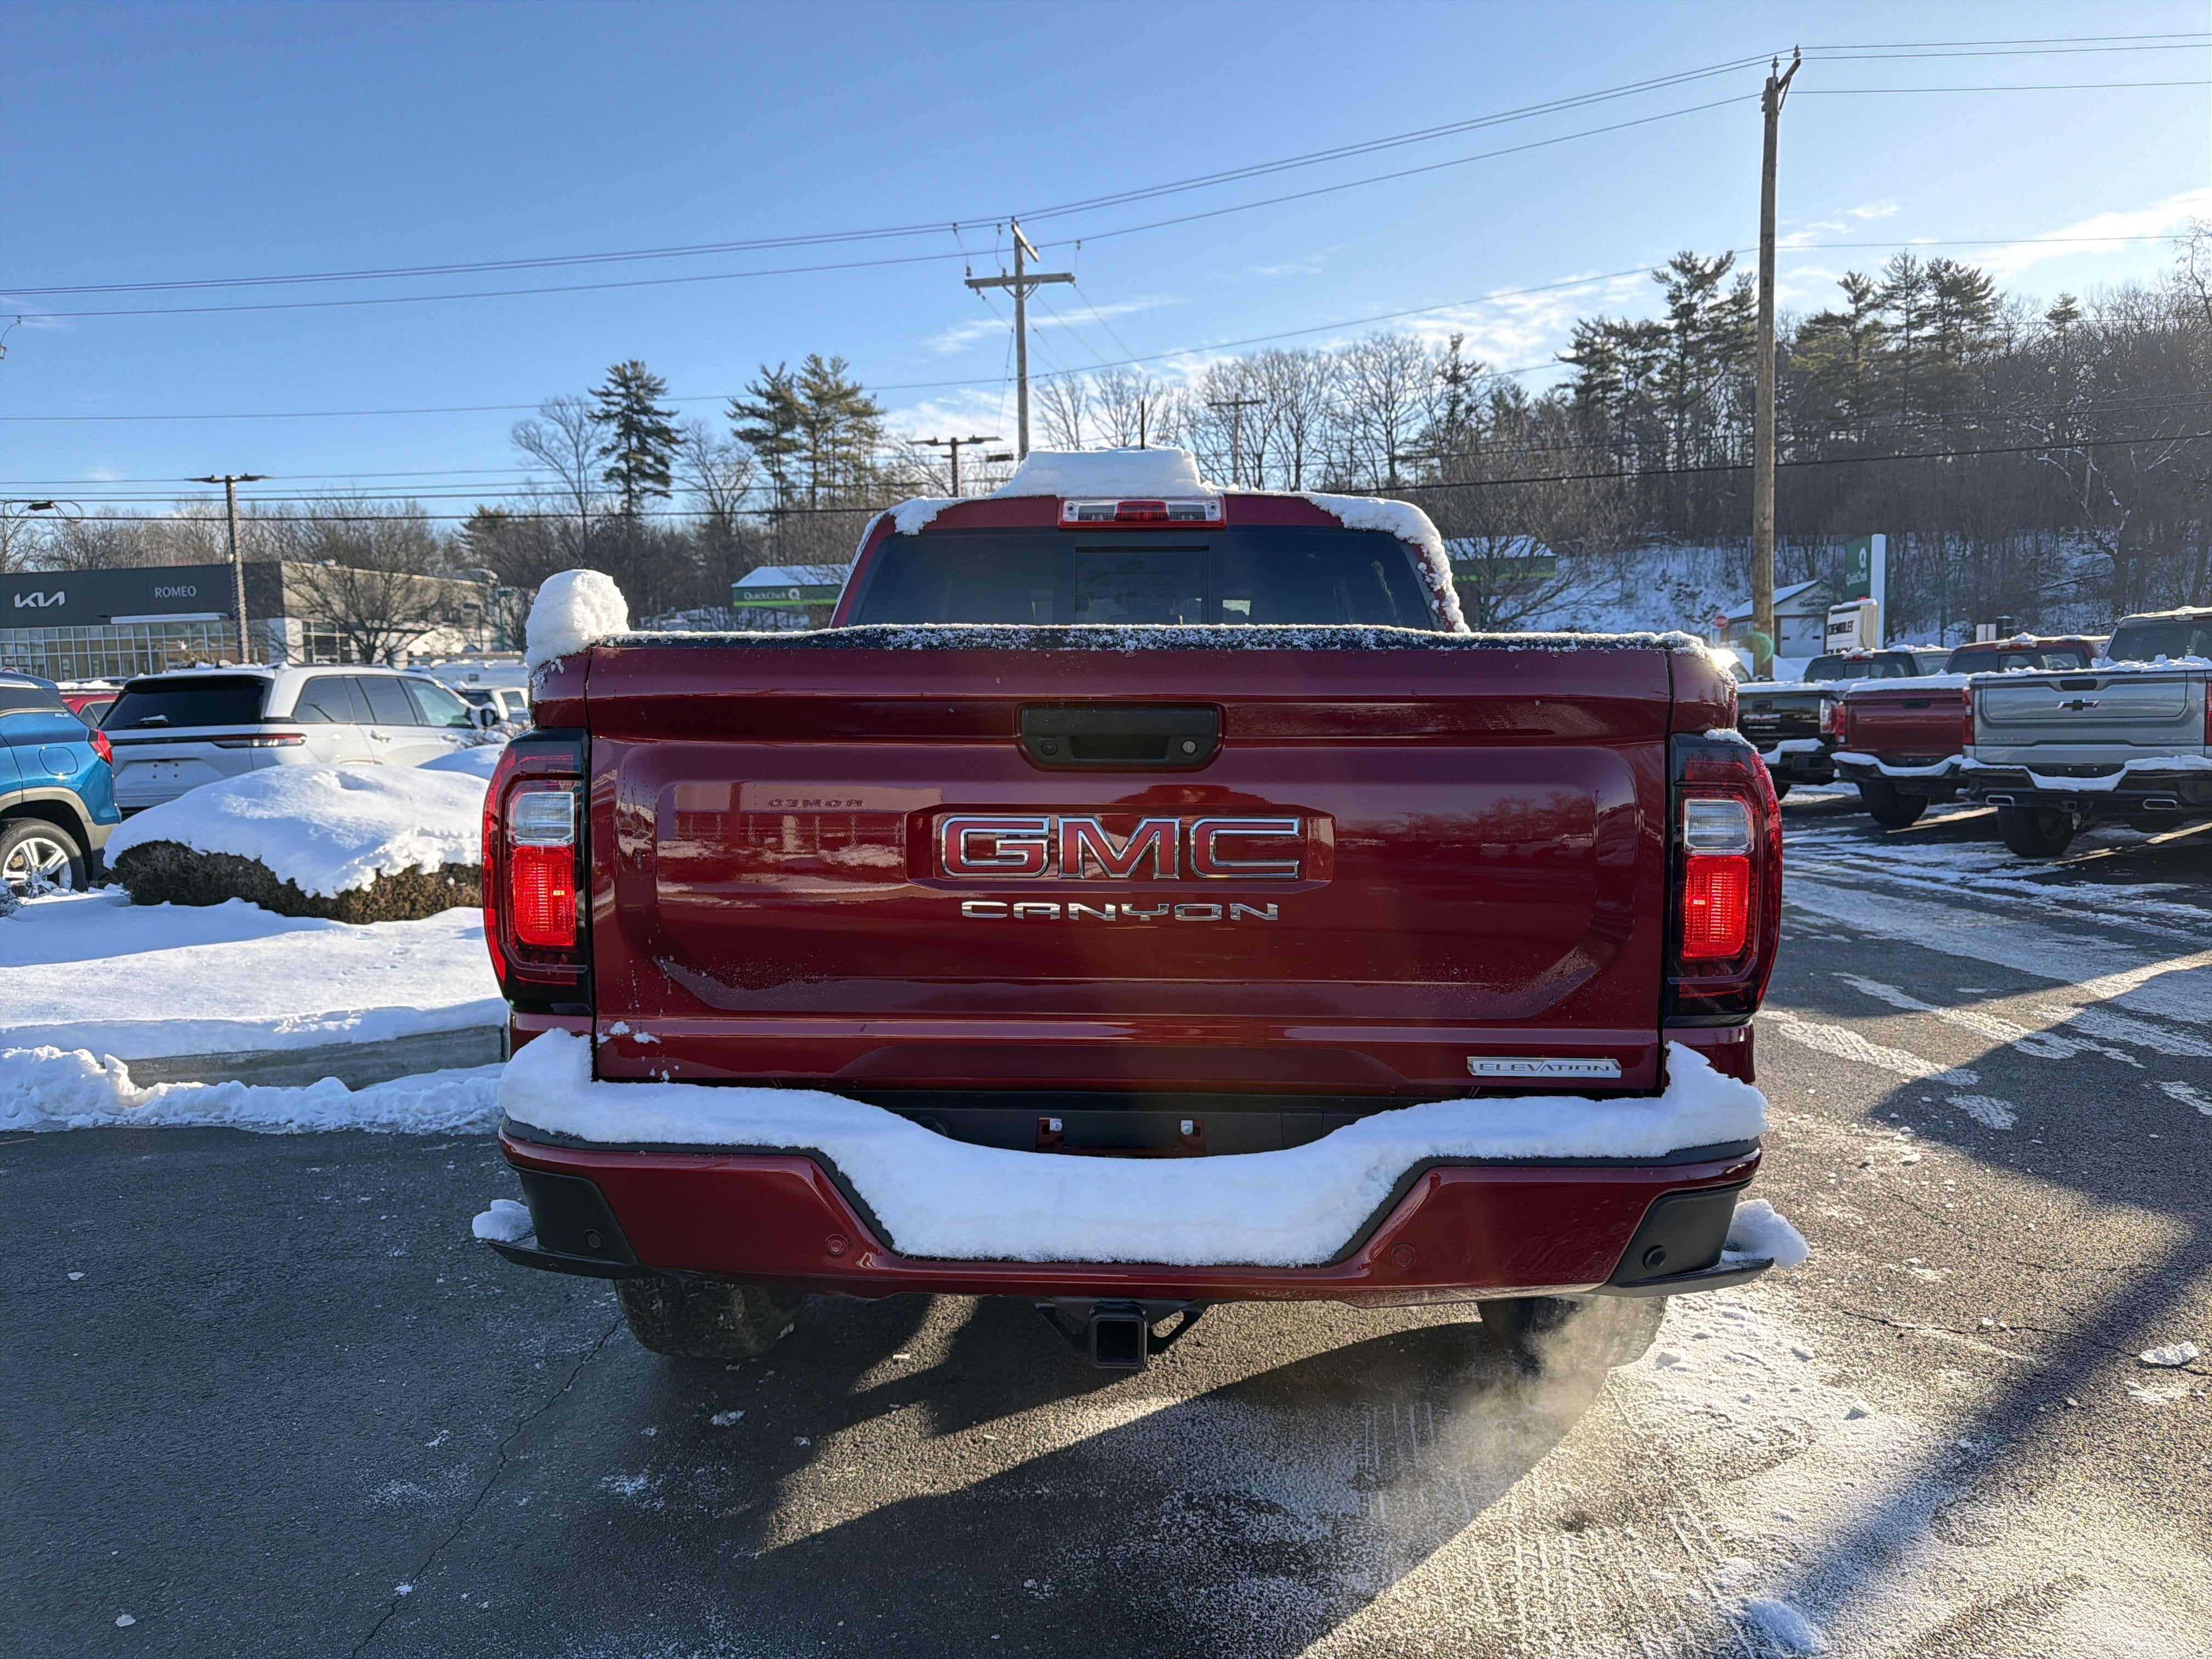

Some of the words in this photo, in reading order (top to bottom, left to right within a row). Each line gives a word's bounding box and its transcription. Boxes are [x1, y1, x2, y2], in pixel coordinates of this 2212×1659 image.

[14, 591, 66, 608] KIA
[154, 585, 197, 599] ROMEO
[941, 816, 1300, 879] GMC
[961, 901, 1279, 921] CANYON
[1479, 1062, 1610, 1073] ELEVATION
